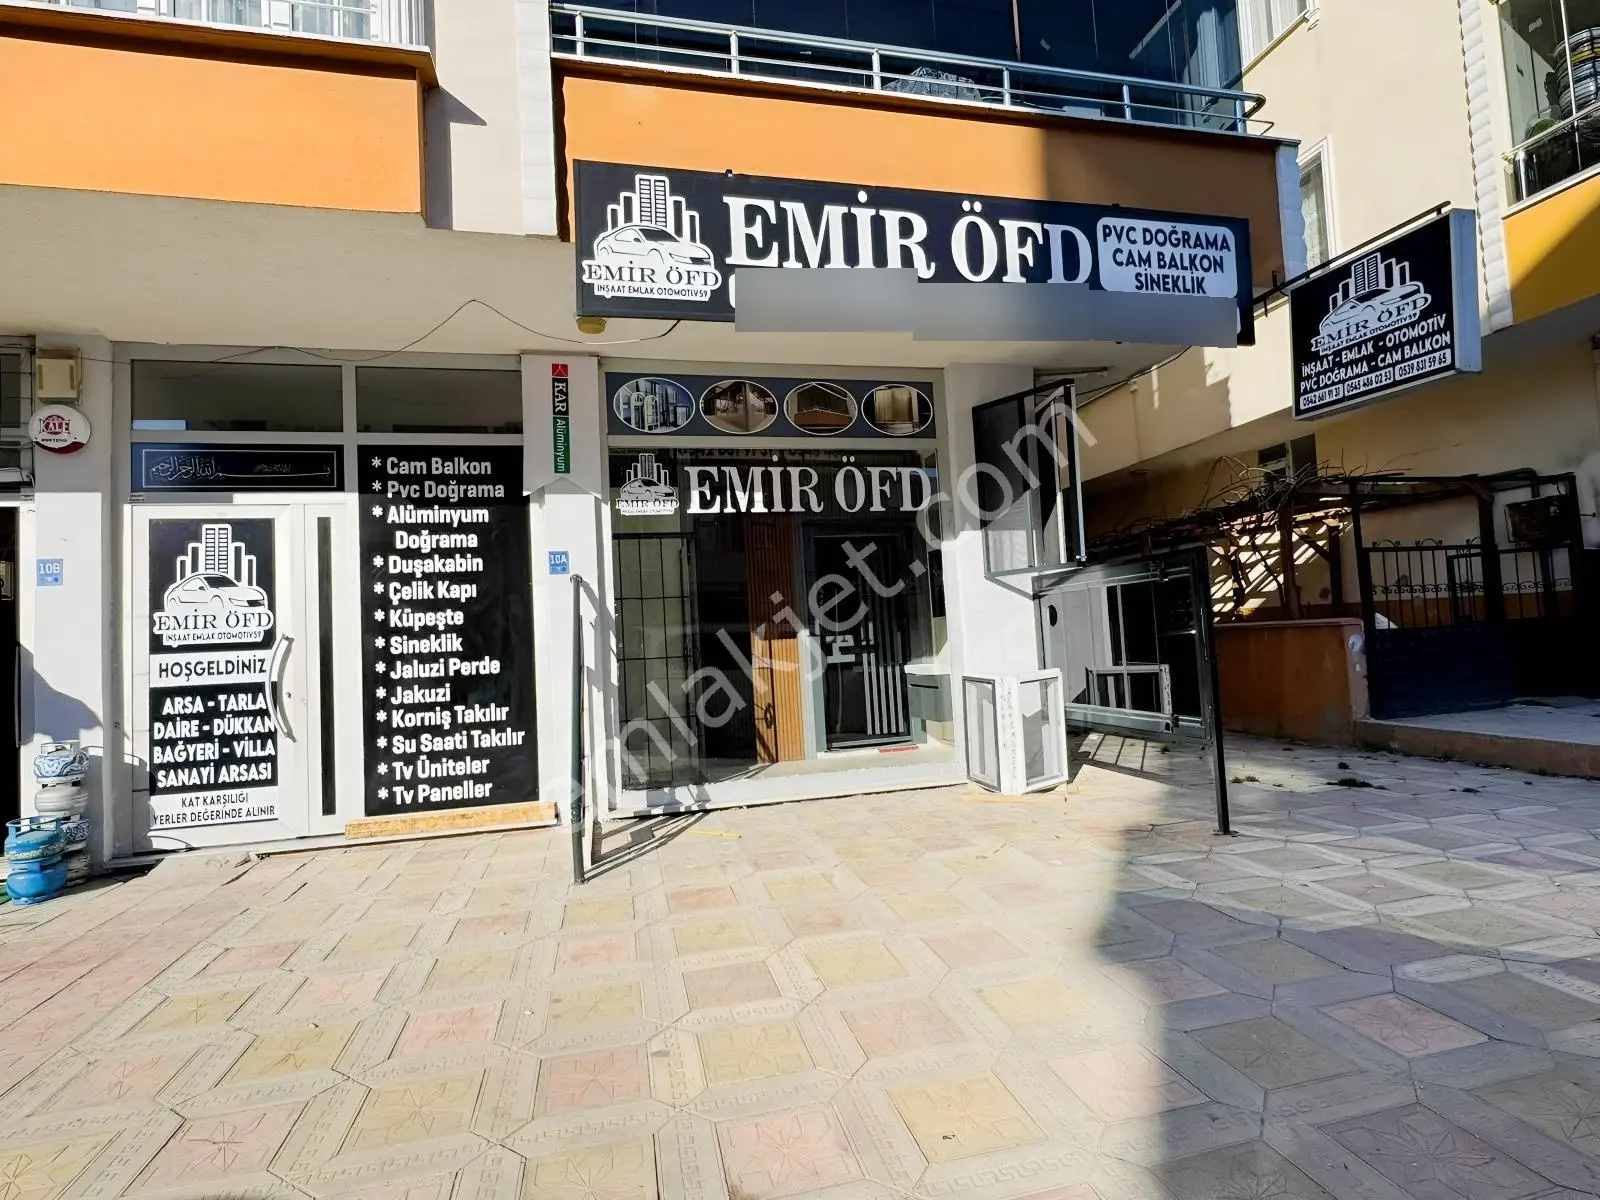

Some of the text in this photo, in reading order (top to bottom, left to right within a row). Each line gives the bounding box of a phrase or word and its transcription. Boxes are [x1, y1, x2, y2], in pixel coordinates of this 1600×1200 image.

[723, 190, 1093, 284] EMİR ÖFD
[1103, 224, 1231, 252] PVC DOĞRAMA
[1112, 248, 1224, 273] CAM BALKON
[586, 260, 719, 287] EMİR ÖFD
[1134, 268, 1207, 294] SİNEKLİK
[628, 285, 655, 294] EMLAK
[1314, 296, 1430, 348] EMİR ÖFD
[1301, 356, 1334, 377] İNŞAAT
[1341, 341, 1374, 362] EMLAK
[1385, 313, 1446, 347] OTOMOTİV
[1300, 379, 1318, 393] PVC
[1319, 359, 1369, 387] DOĞRAMA
[1377, 350, 1402, 367] CAM
[1404, 331, 1451, 358] BALKON
[1428, 358, 1437, 368] 59
[1438, 352, 1447, 365] 65
[1374, 373, 1383, 384] 02
[554, 381, 567, 412] KAR
[39, 418, 72, 434] KALE
[386, 457, 491, 475] Cam Balkon
[387, 480, 505, 502] Pvc Doğrama
[684, 454, 932, 513] EMİR ÖFD
[387, 505, 489, 527] Alüminyum
[395, 530, 478, 553] Doğrama
[39, 563, 60, 574] 10B
[388, 554, 483, 578] Duşakabin
[549, 554, 568, 564] 10A
[388, 581, 477, 605] Çelik Kapı
[157, 609, 271, 631] EMİR ÖFD
[389, 608, 464, 631] Küpeşte
[390, 633, 463, 654] Sineklik
[159, 655, 267, 681] HOŞGELDİNİZ
[390, 656, 500, 679] Jaluzi Perde
[162, 695, 204, 715] ARSA
[218, 692, 267, 712] TARLA
[390, 683, 450, 705] Jakuzi
[153, 717, 199, 740] DAİRE
[213, 714, 275, 735] DÜKKAN
[392, 703, 509, 729] Korniş Takılır
[153, 738, 219, 763] BAĞYERİ
[233, 737, 275, 758] VİLLA
[392, 727, 525, 754] Su Saati Takılır
[157, 762, 272, 788] SANAYİ ARSASI
[392, 755, 490, 780] Tv Üniteler
[181, 791, 249, 808] KAT KARŞILIĞI
[392, 780, 493, 805] Tv Paneller
[153, 805, 275, 824] YERLER DEĞERİNDE ALINIR
